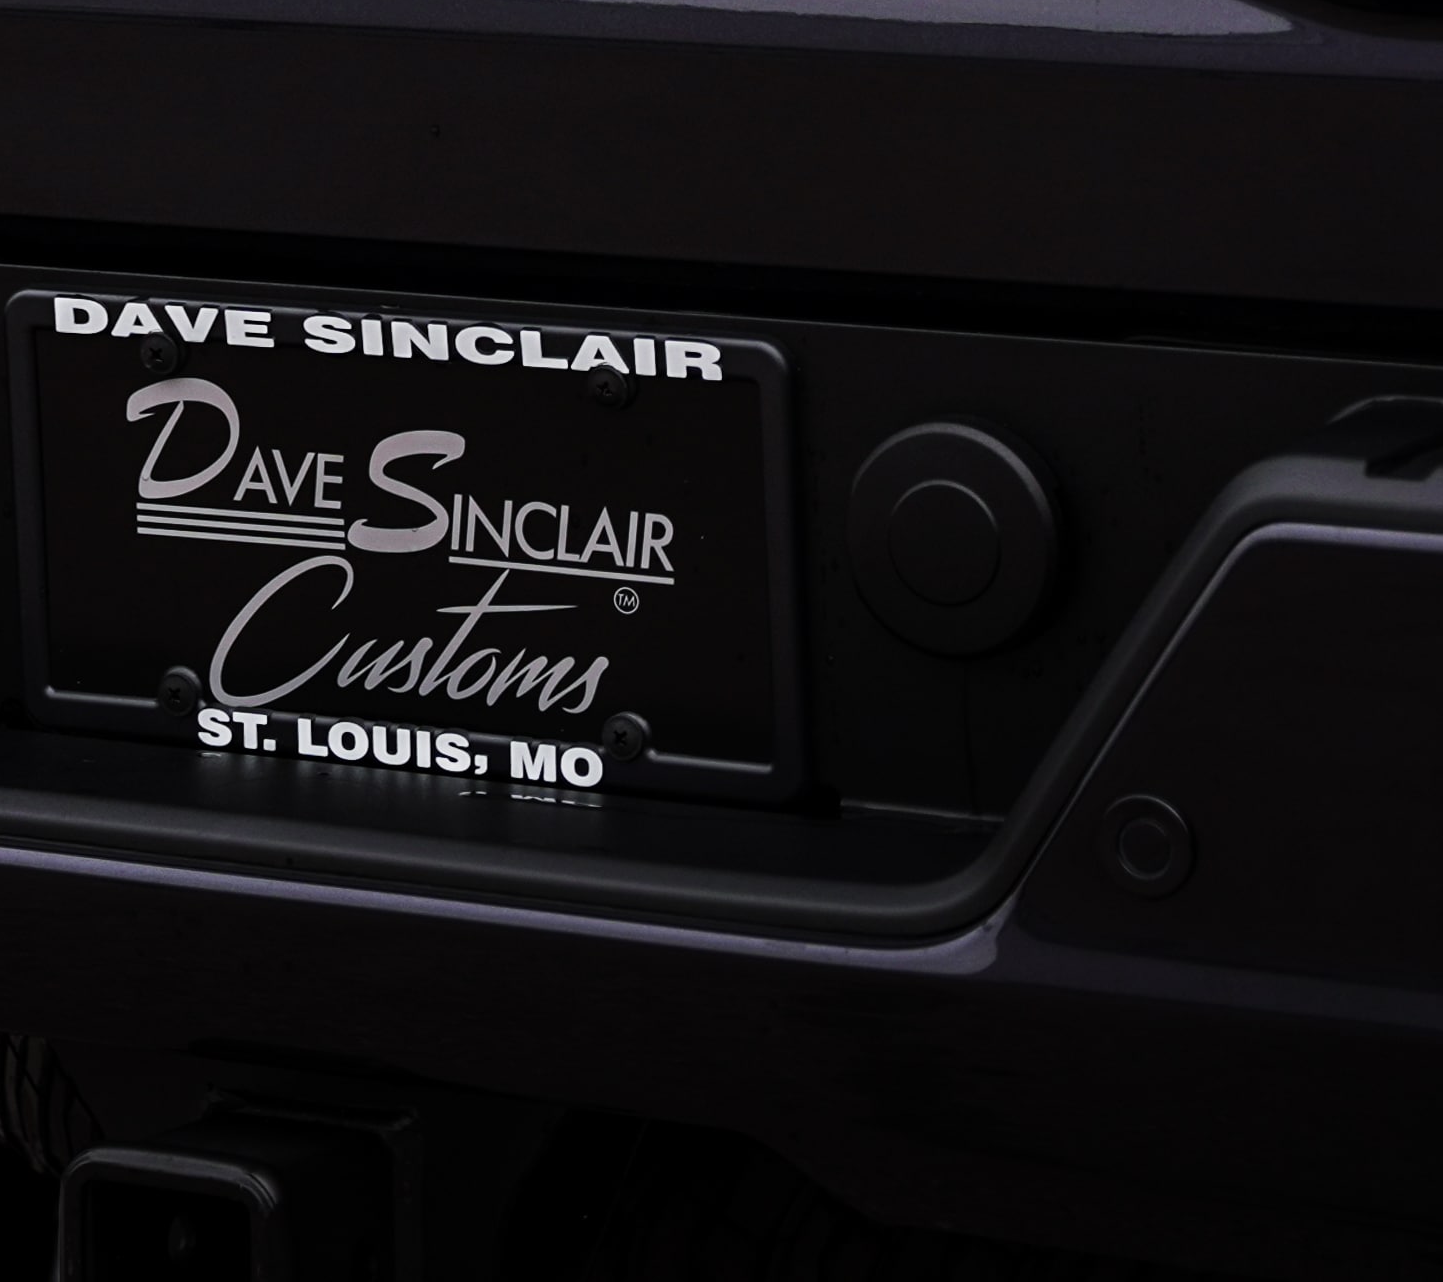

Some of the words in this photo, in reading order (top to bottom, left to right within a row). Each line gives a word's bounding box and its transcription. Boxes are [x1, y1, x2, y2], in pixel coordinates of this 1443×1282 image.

[54, 296, 275, 349] DAVE
[303, 314, 723, 382] SINCLAIR
[208, 555, 611, 715] Customs
[196, 708, 277, 752] ST.
[296, 717, 489, 776] LOUIS,
[509, 740, 605, 788] MO
